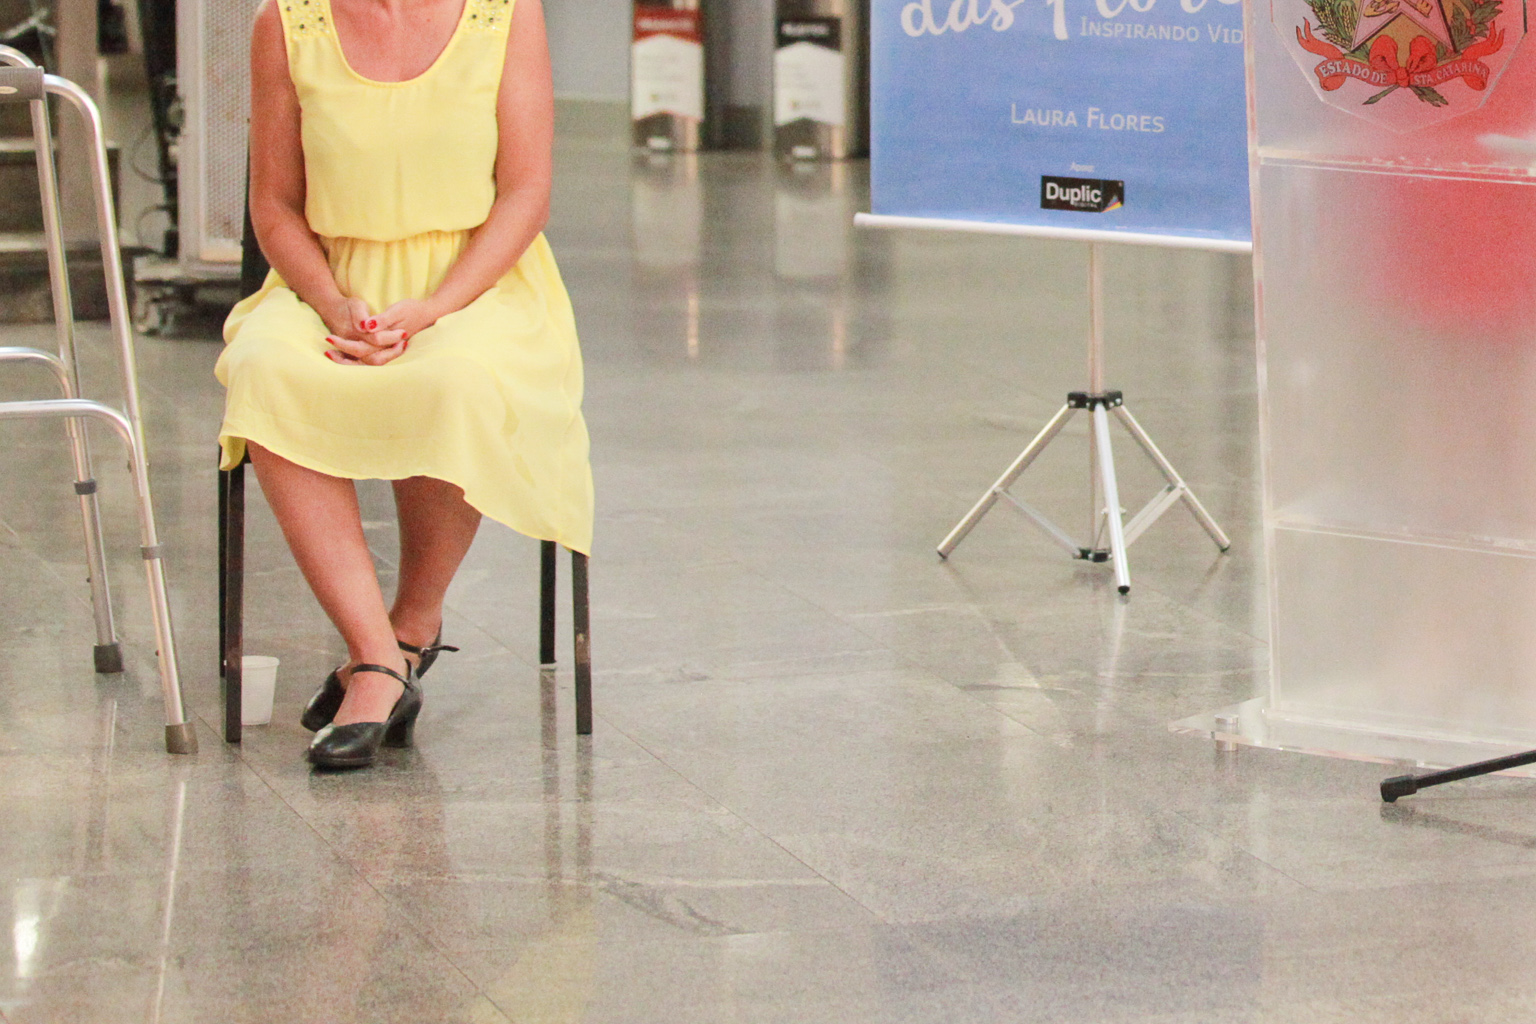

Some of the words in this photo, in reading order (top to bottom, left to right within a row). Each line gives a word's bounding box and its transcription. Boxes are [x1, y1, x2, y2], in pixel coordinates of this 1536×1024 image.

[1080, 16, 1199, 42] INSPIRANDO
[1207, 23, 1244, 43] VID
[1319, 58, 1370, 80] ESTADO
[1370, 71, 1388, 84] DE
[1011, 103, 1078, 128] LAURA
[1087, 107, 1165, 133] FLORES
[1045, 182, 1102, 206] Duplic
